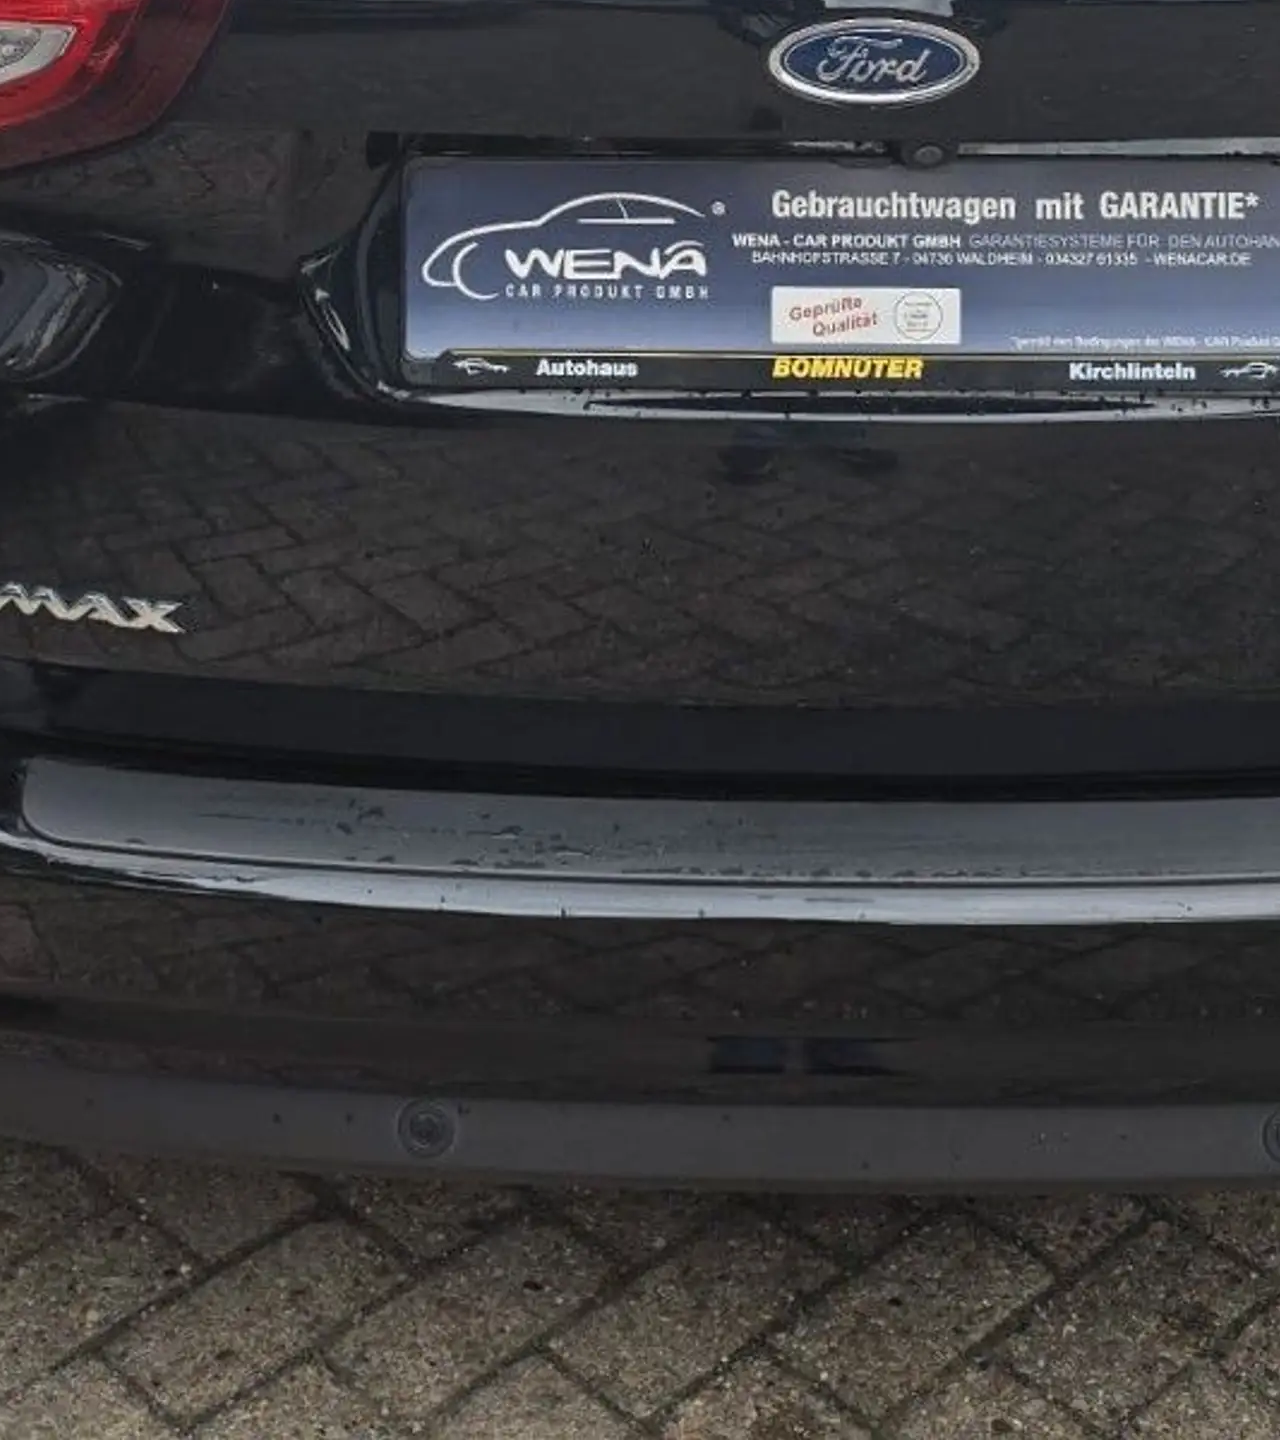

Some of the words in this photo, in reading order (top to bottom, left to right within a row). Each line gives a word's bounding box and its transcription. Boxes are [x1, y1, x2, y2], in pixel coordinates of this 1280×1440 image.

[817, 36, 933, 83] Ford
[772, 189, 1016, 224] Gebrauchtwagen
[1035, 192, 1084, 220] mit
[732, 233, 780, 248] WENA
[793, 233, 828, 248] CAR
[832, 234, 908, 248] PRODUKT
[1127, 232, 1160, 248] FÜR
[1168, 234, 1201, 249] DEN
[505, 241, 708, 280] WENA
[505, 284, 542, 298] CAR
[554, 284, 643, 299] PRODUKT
[656, 284, 709, 299] GMBH
[812, 312, 878, 338] Qualität
[536, 358, 638, 377] Autohaus
